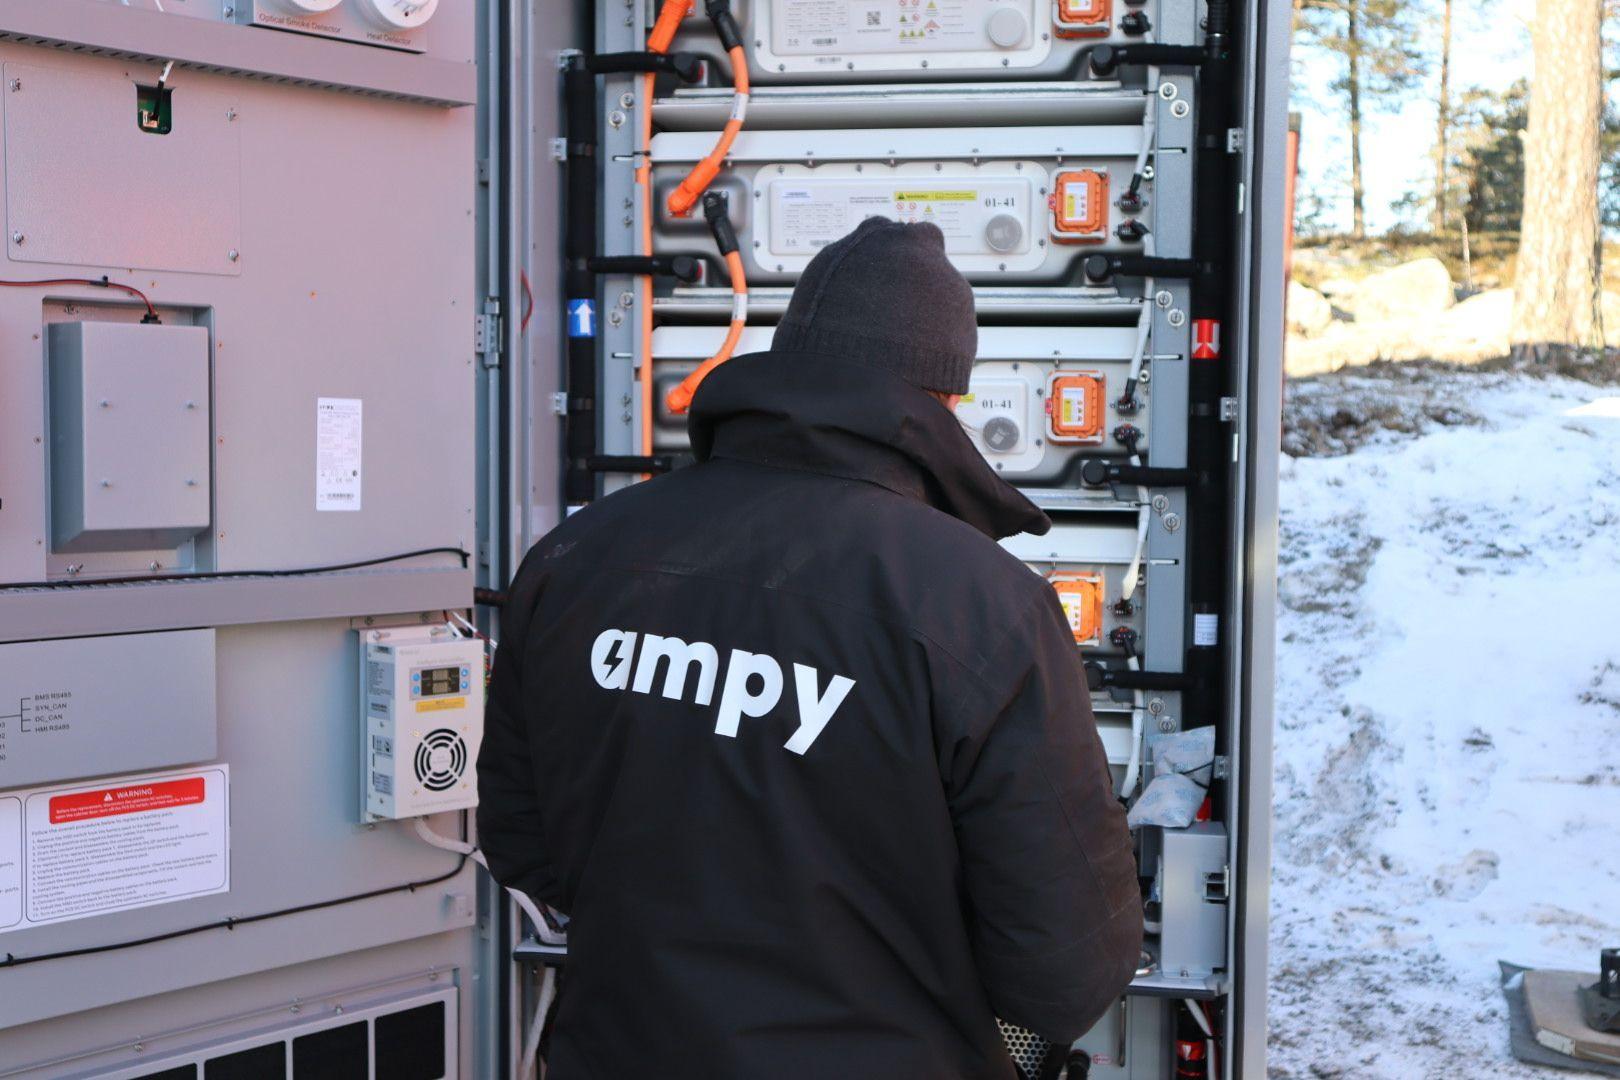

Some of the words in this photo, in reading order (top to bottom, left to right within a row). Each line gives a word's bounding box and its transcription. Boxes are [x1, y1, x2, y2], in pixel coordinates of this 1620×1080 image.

[259, 13, 285, 24] Optical
[286, 17, 310, 28] Smoke
[311, 22, 342, 33] Detector
[366, 32, 382, 40] Heat
[383, 34, 412, 45] Detector
[985, 197, 1015, 208] 01-41
[982, 399, 1012, 409] 01-41
[34, 693, 50, 701] BMS
[591, 629, 856, 756] ampy
[117, 788, 153, 799] WARNING
